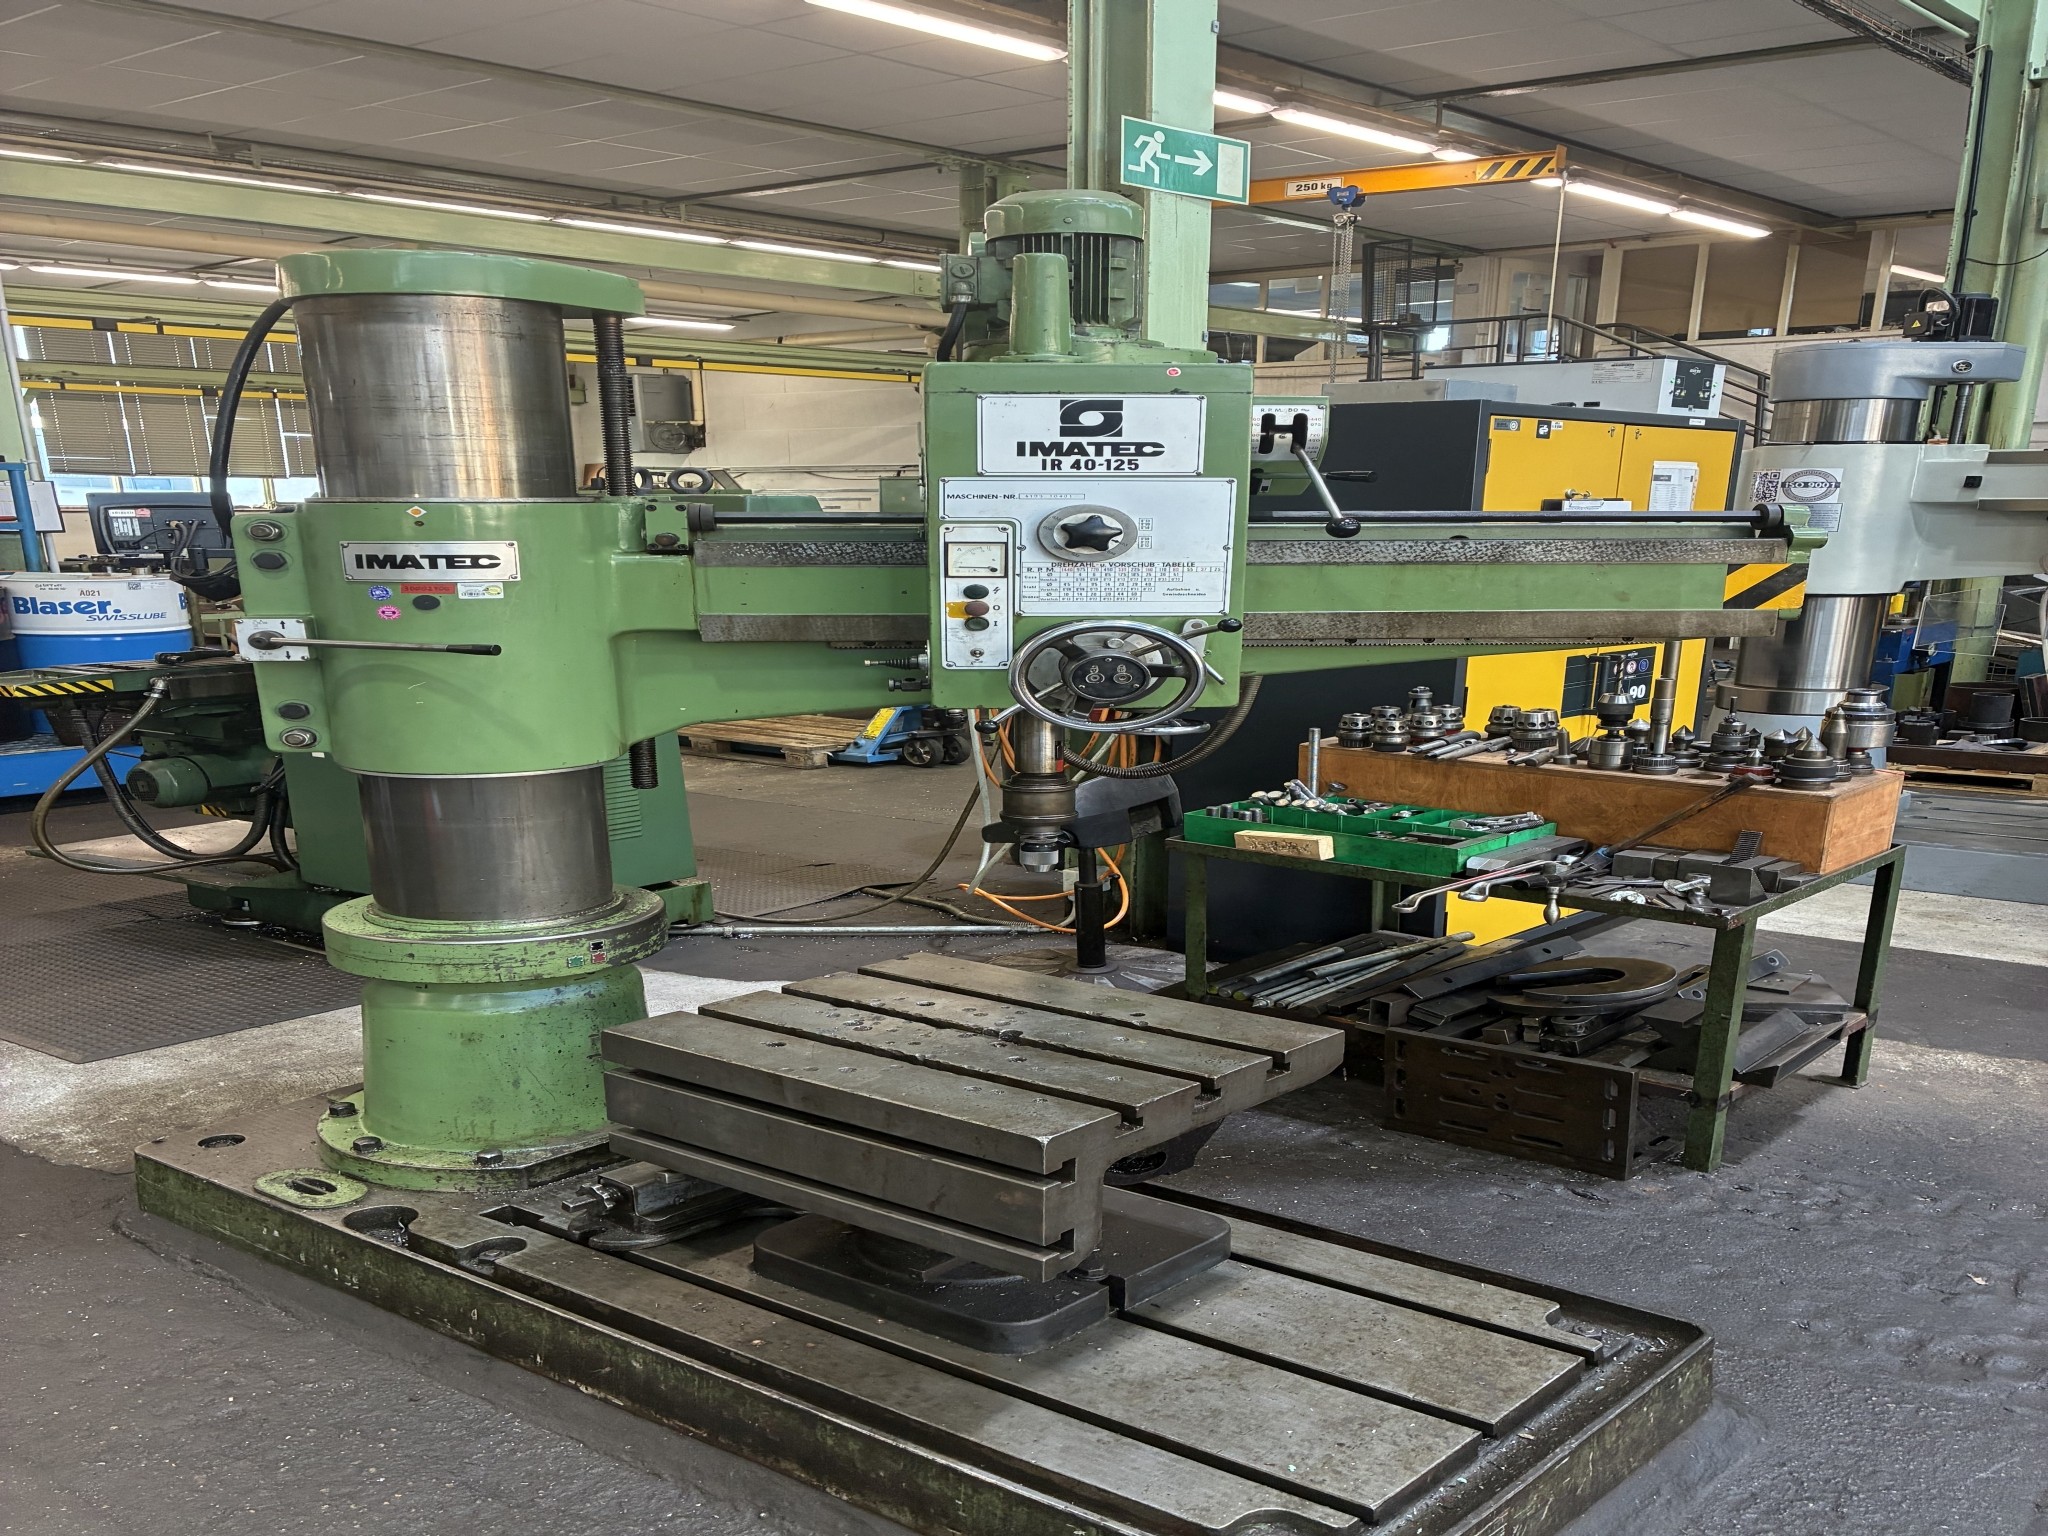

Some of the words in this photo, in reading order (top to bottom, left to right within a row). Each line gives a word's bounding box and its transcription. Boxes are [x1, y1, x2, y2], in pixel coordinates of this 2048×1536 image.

[1295, 182, 1318, 192] 250
[1320, 182, 1333, 191] kg
[1016, 441, 1166, 457] IMATEC
[1041, 458, 1062, 471] IR
[1070, 458, 1139, 471] 40-125
[354, 554, 502, 570] IMATEC
[79, 589, 101, 597] A021
[86, 611, 168, 622] SWISSLUBE
[1629, 684, 1646, 699] 90
